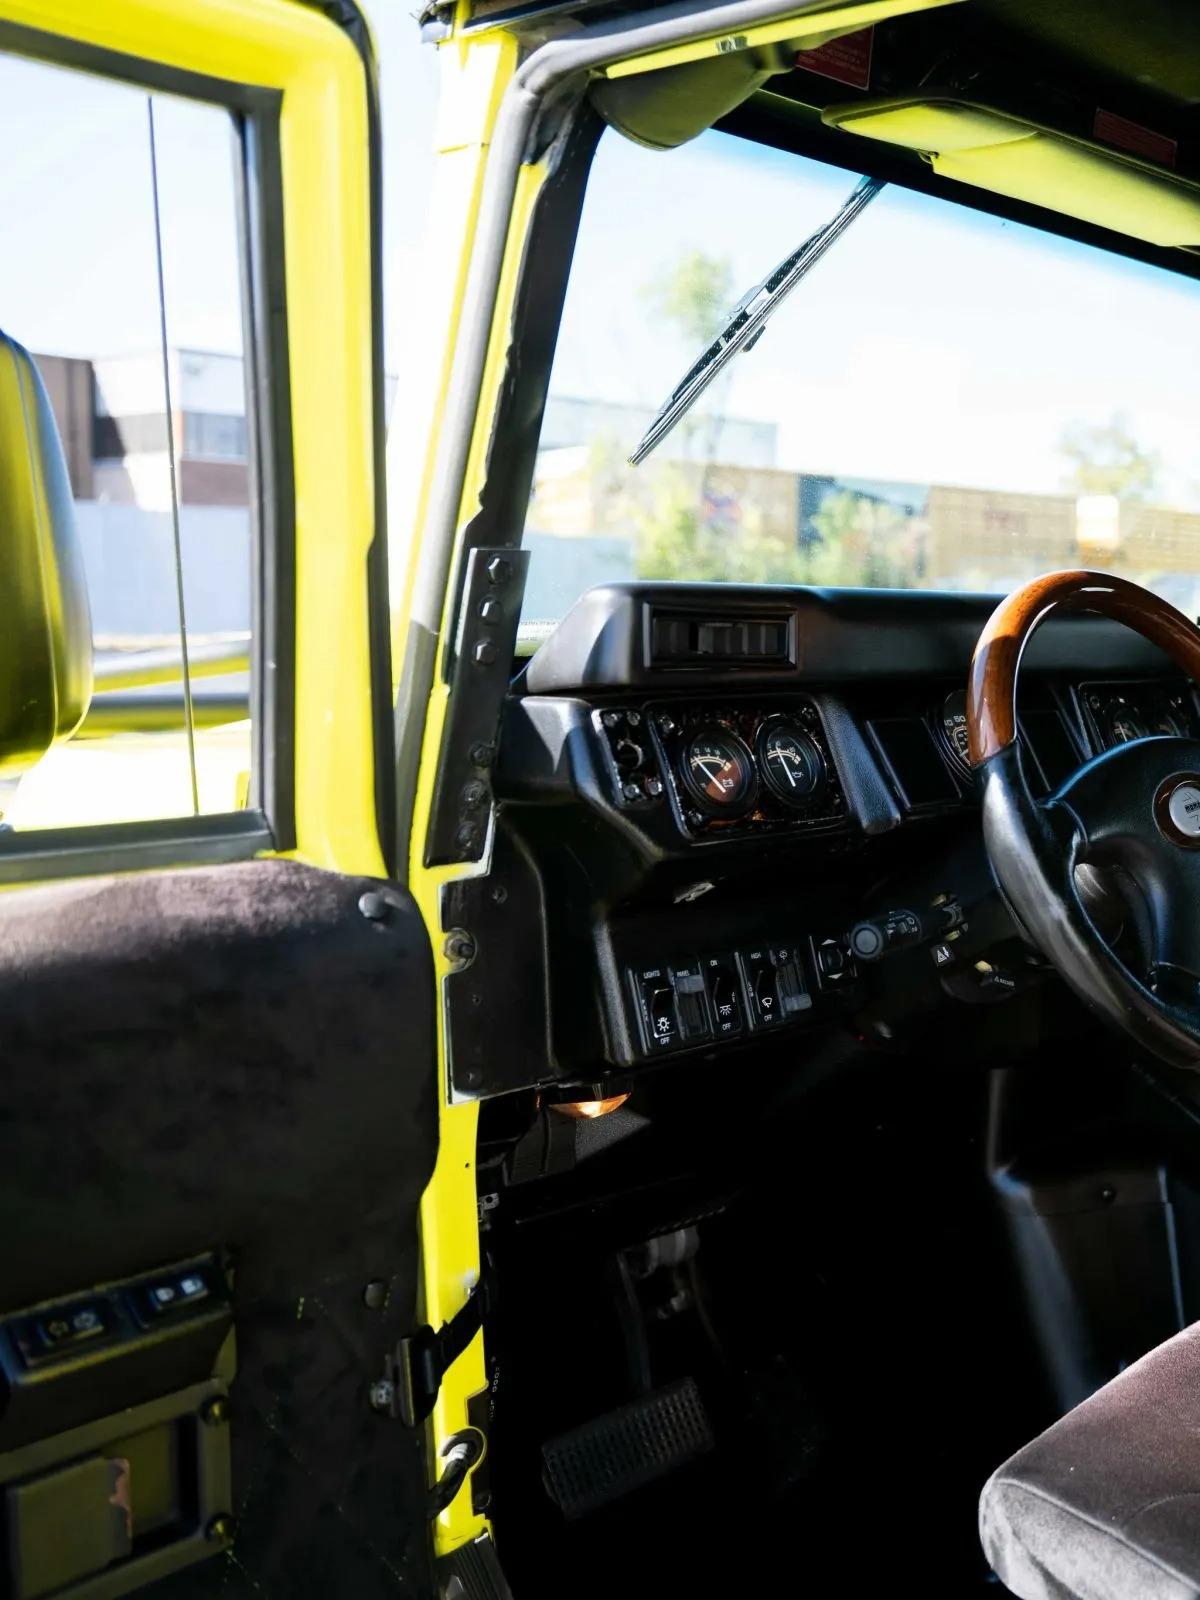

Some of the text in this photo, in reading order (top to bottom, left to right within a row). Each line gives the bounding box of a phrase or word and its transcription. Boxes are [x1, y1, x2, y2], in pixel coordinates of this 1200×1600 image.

[763, 1014, 773, 1022] OFF
[722, 1022, 731, 1031] OFF
[660, 1037, 670, 1045] OFF
